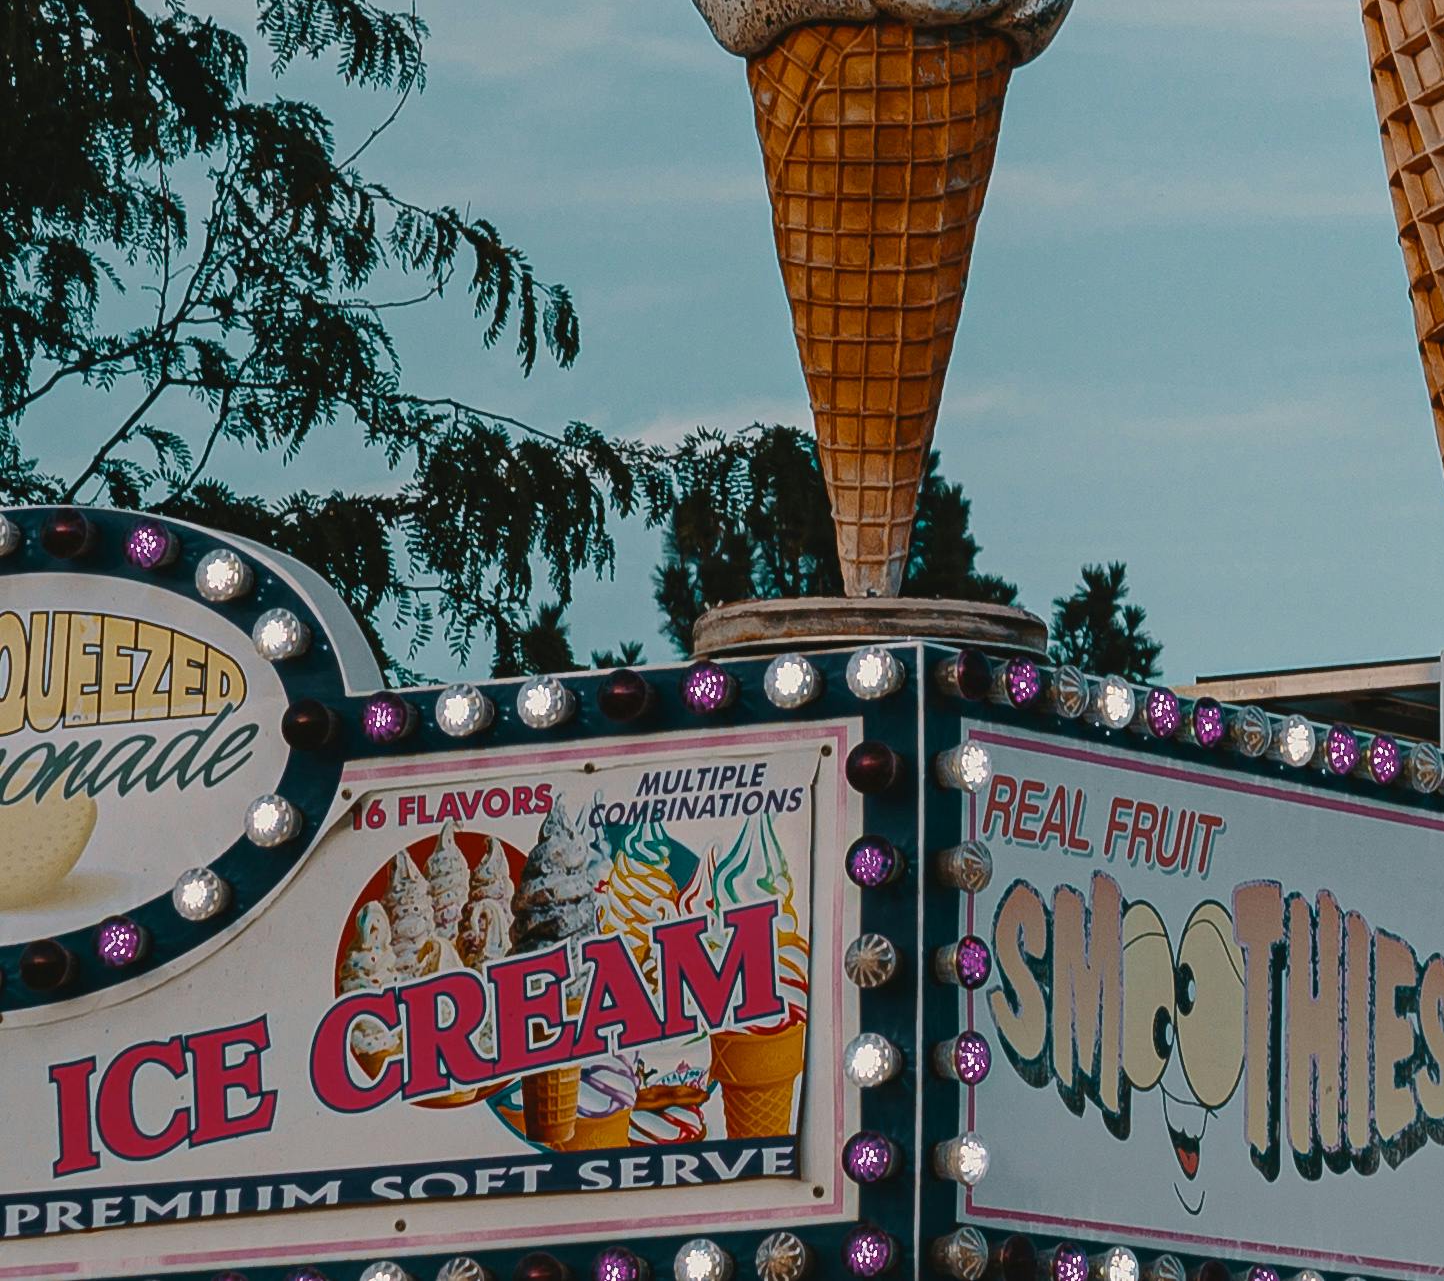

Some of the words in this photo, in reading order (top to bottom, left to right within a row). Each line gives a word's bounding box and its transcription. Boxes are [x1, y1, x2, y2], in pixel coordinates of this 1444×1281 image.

[0, 702, 259, 806] onade
[635, 762, 768, 797] MULTIPLE
[351, 798, 387, 831] 16
[398, 783, 552, 827] FLAVORS
[588, 786, 803, 829] COMBINATIONS
[983, 774, 1090, 857] REAL
[1104, 797, 1226, 880] FRUIT
[50, 1015, 278, 1178] ICE
[310, 901, 784, 1114] CREAM
[371, 1163, 552, 1200] SOFT
[578, 1146, 795, 1191] SERVE
